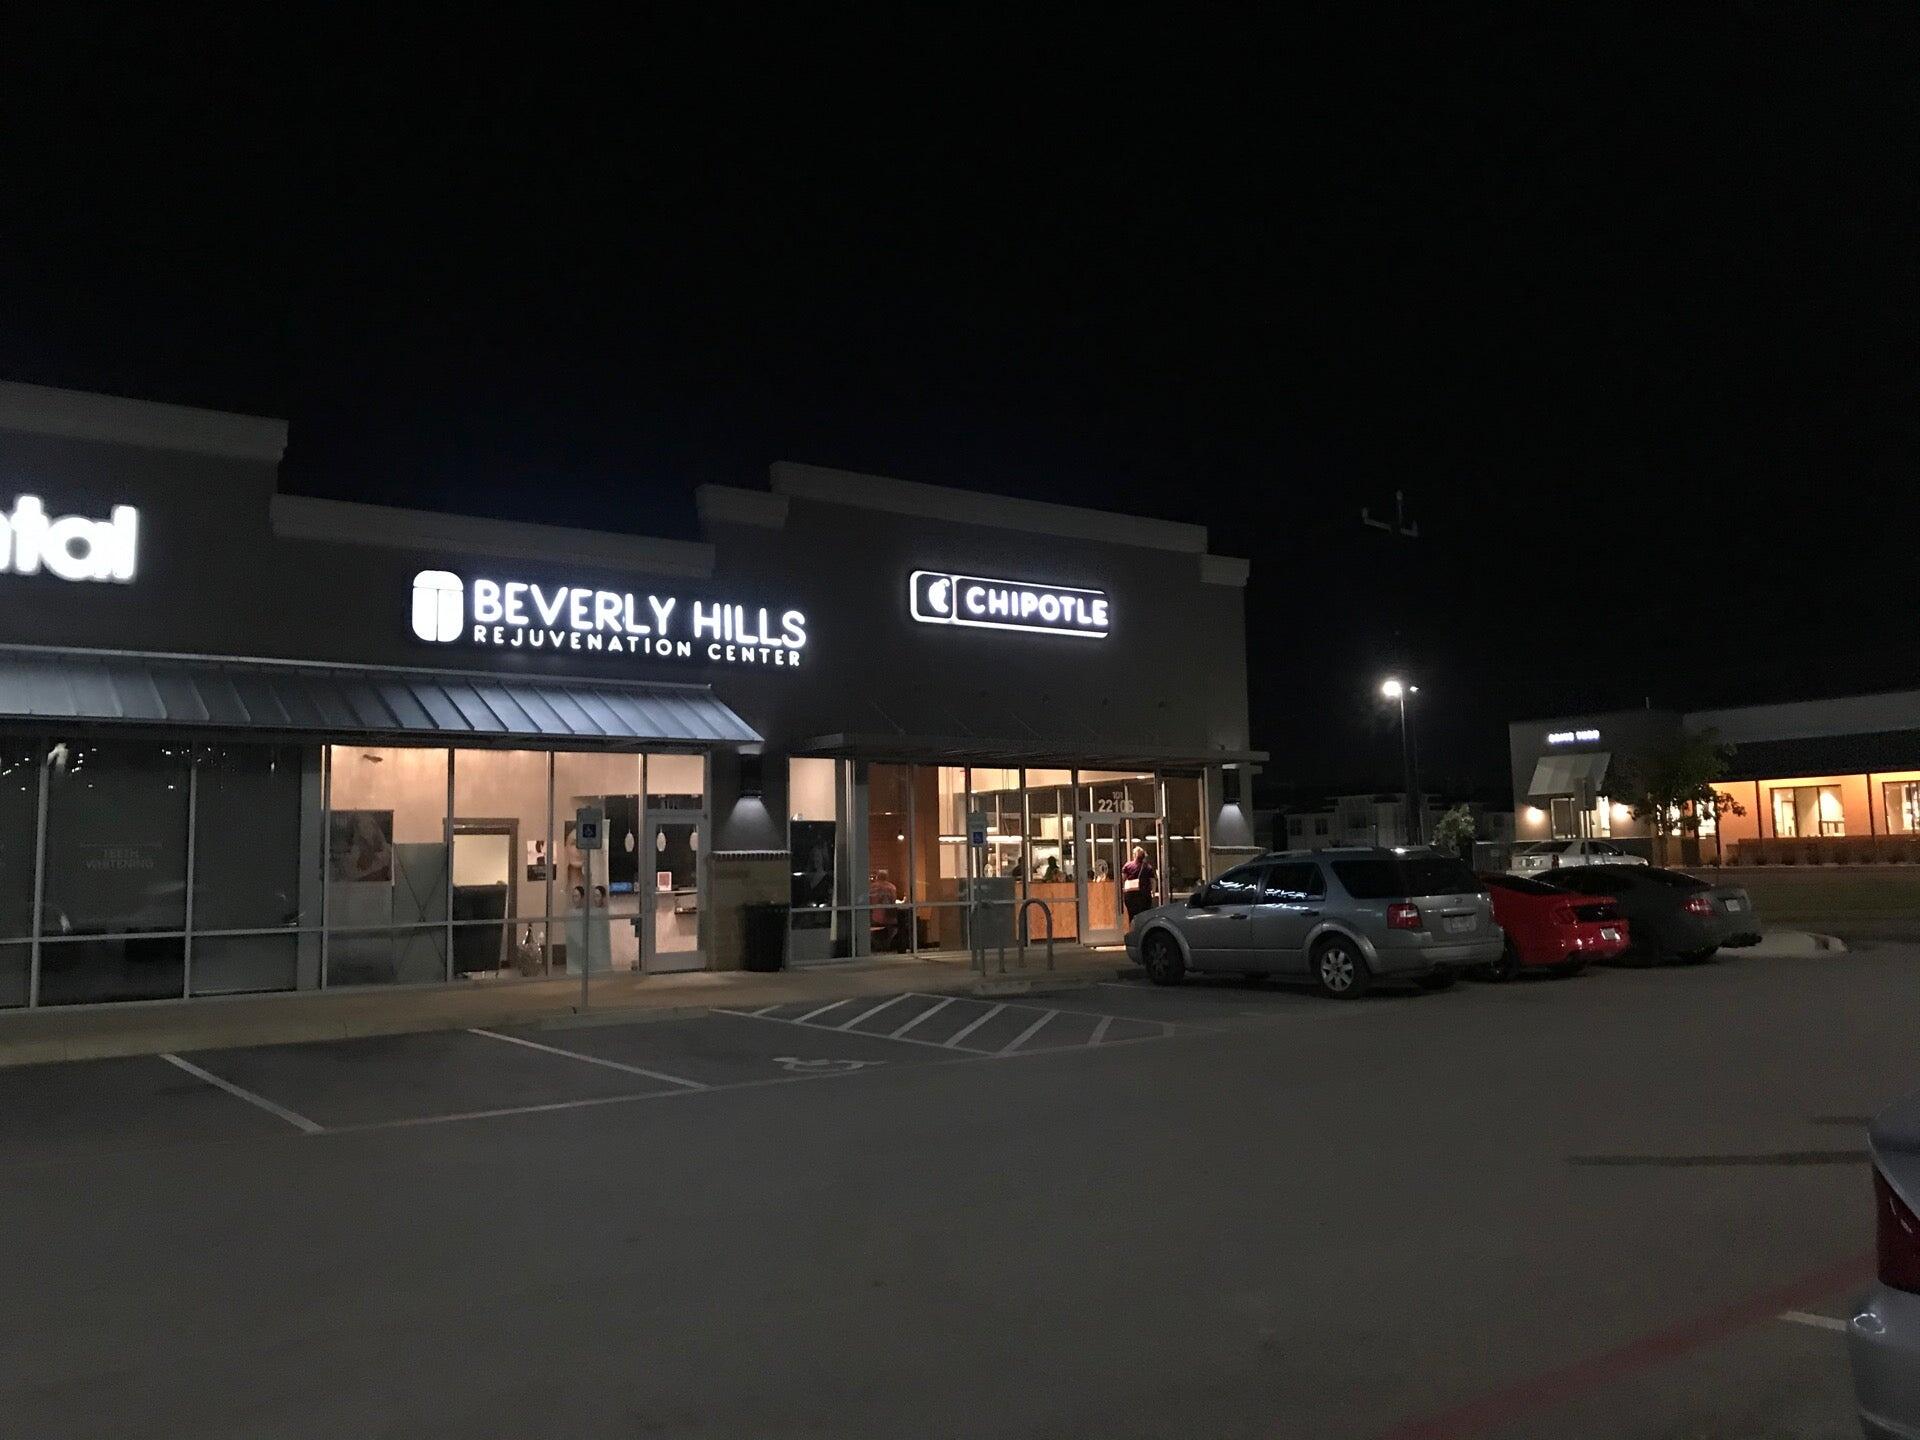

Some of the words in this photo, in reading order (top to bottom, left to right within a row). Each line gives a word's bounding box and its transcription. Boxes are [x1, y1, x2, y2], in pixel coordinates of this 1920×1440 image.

[474, 579, 676, 636] BEVERLY
[693, 600, 807, 648] HILLS
[965, 586, 1109, 626] CHIPOTLE
[474, 624, 691, 657] REJUVENATION
[707, 643, 800, 667] CENTER
